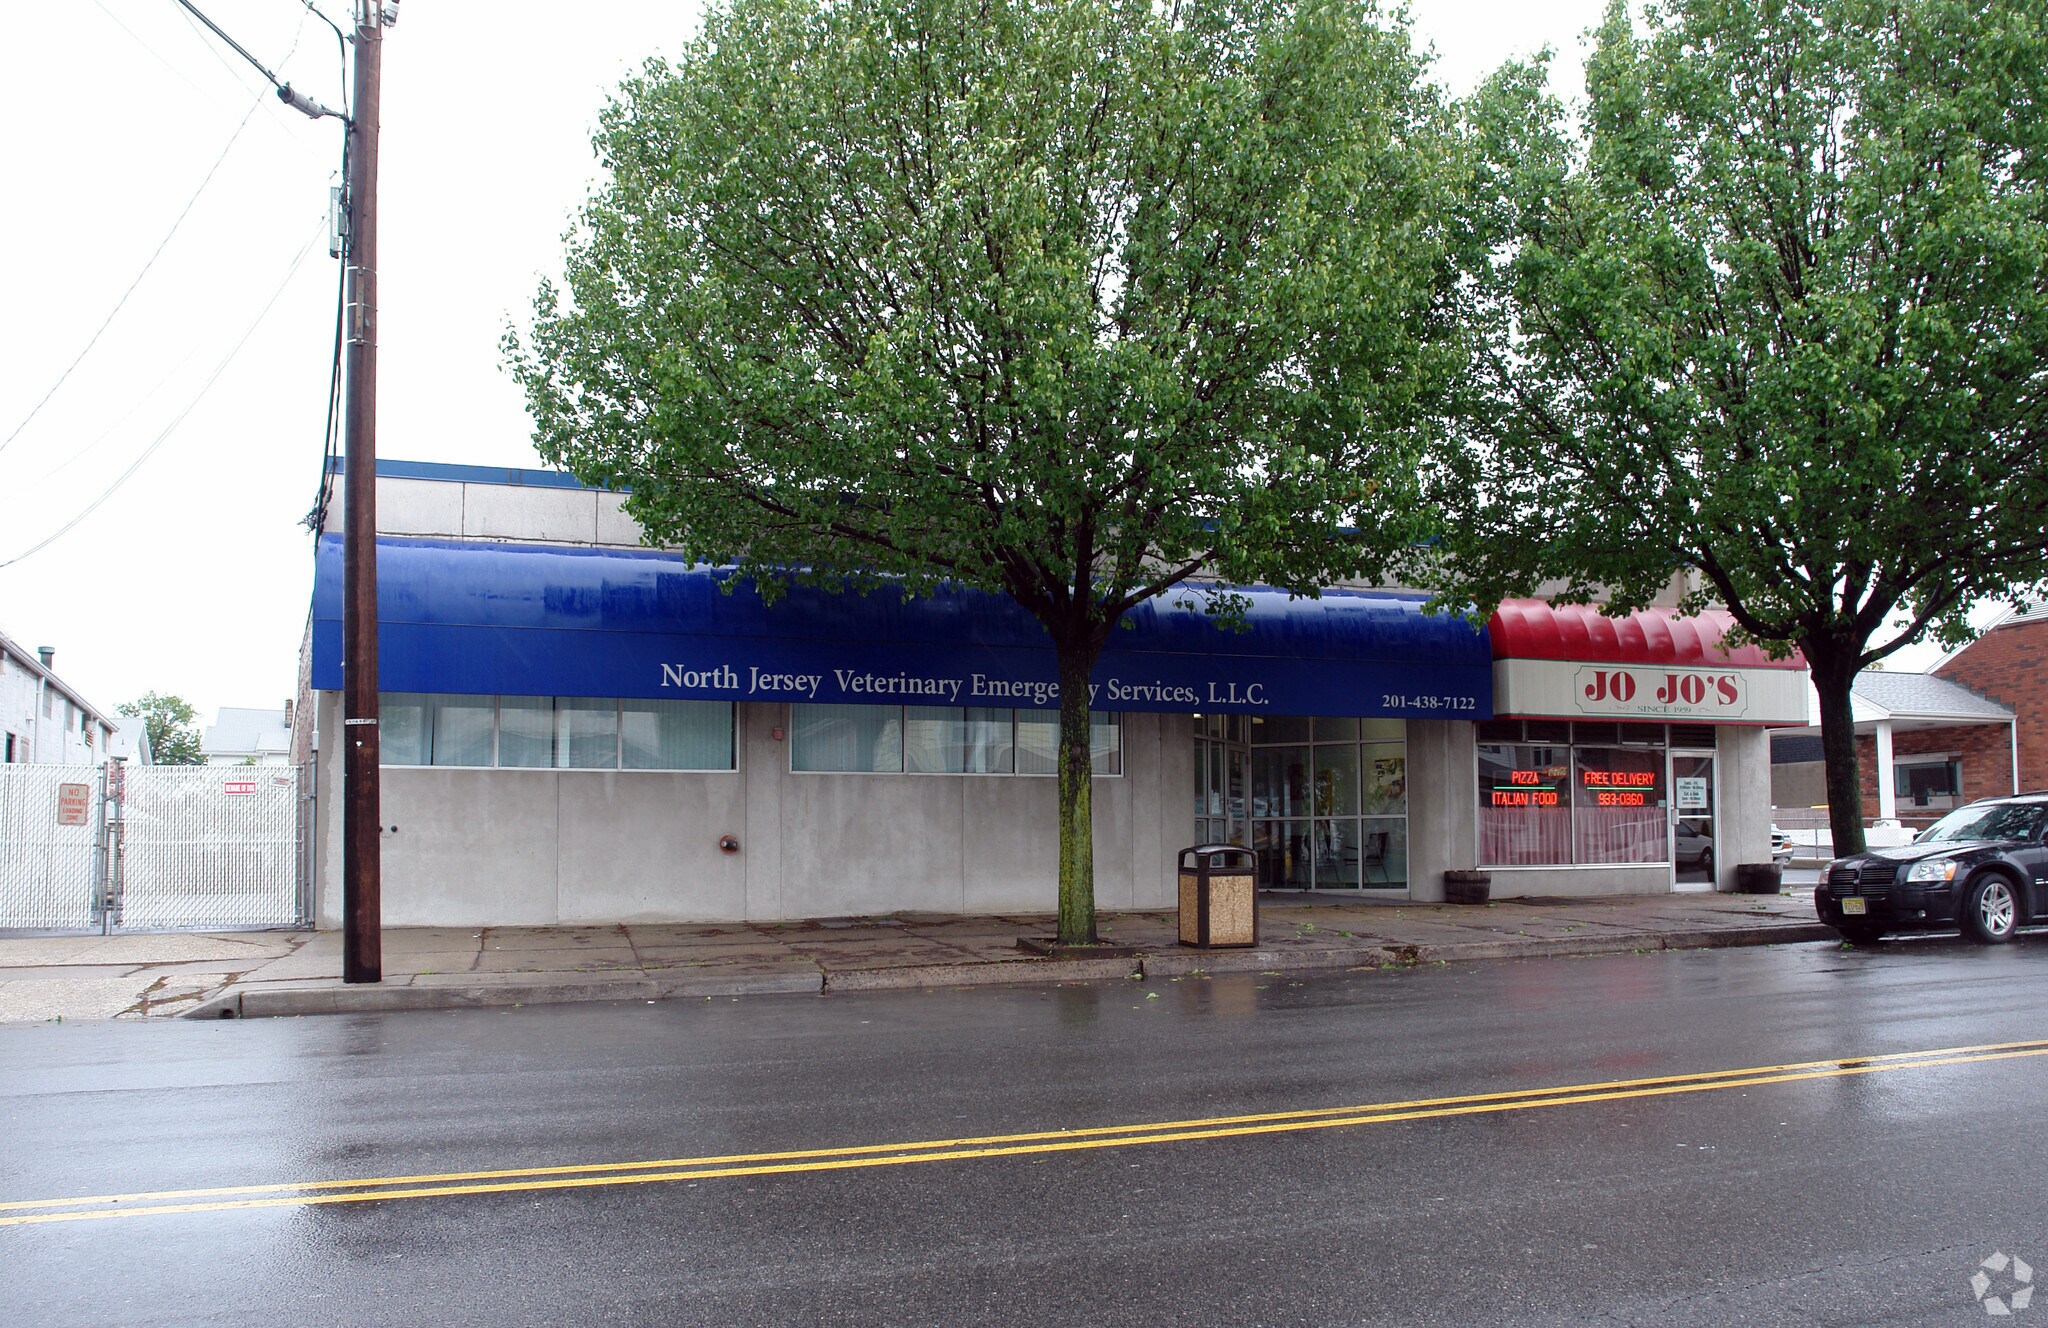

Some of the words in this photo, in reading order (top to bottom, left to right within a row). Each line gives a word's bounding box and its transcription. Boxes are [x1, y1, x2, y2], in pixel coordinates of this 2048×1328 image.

[660, 663, 740, 690] North
[748, 666, 823, 699] Jersey
[833, 669, 964, 703] Veterinary
[970, 673, 1100, 706] Emergey
[1106, 677, 1201, 706] Services,
[1207, 682, 1270, 705] L.L.C.
[1584, 670, 1637, 703] JO
[1656, 673, 1739, 706] JO'S
[1382, 694, 1476, 710] 201-438-7122
[1636, 705, 1673, 713] SINCE
[1511, 770, 1540, 785] PIZZA
[1584, 771, 1610, 785] FREE
[1612, 772, 1655, 786] DELIVERY
[68, 788, 79, 797] NO
[225, 783, 241, 792] BEWARE
[241, 783, 247, 792] OF
[247, 783, 255, 792] DOG
[61, 797, 86, 807] PARKING
[1492, 791, 1528, 806] ITALIAN
[1532, 792, 1558, 806] FOOD
[1598, 792, 1644, 806] 933-0360
